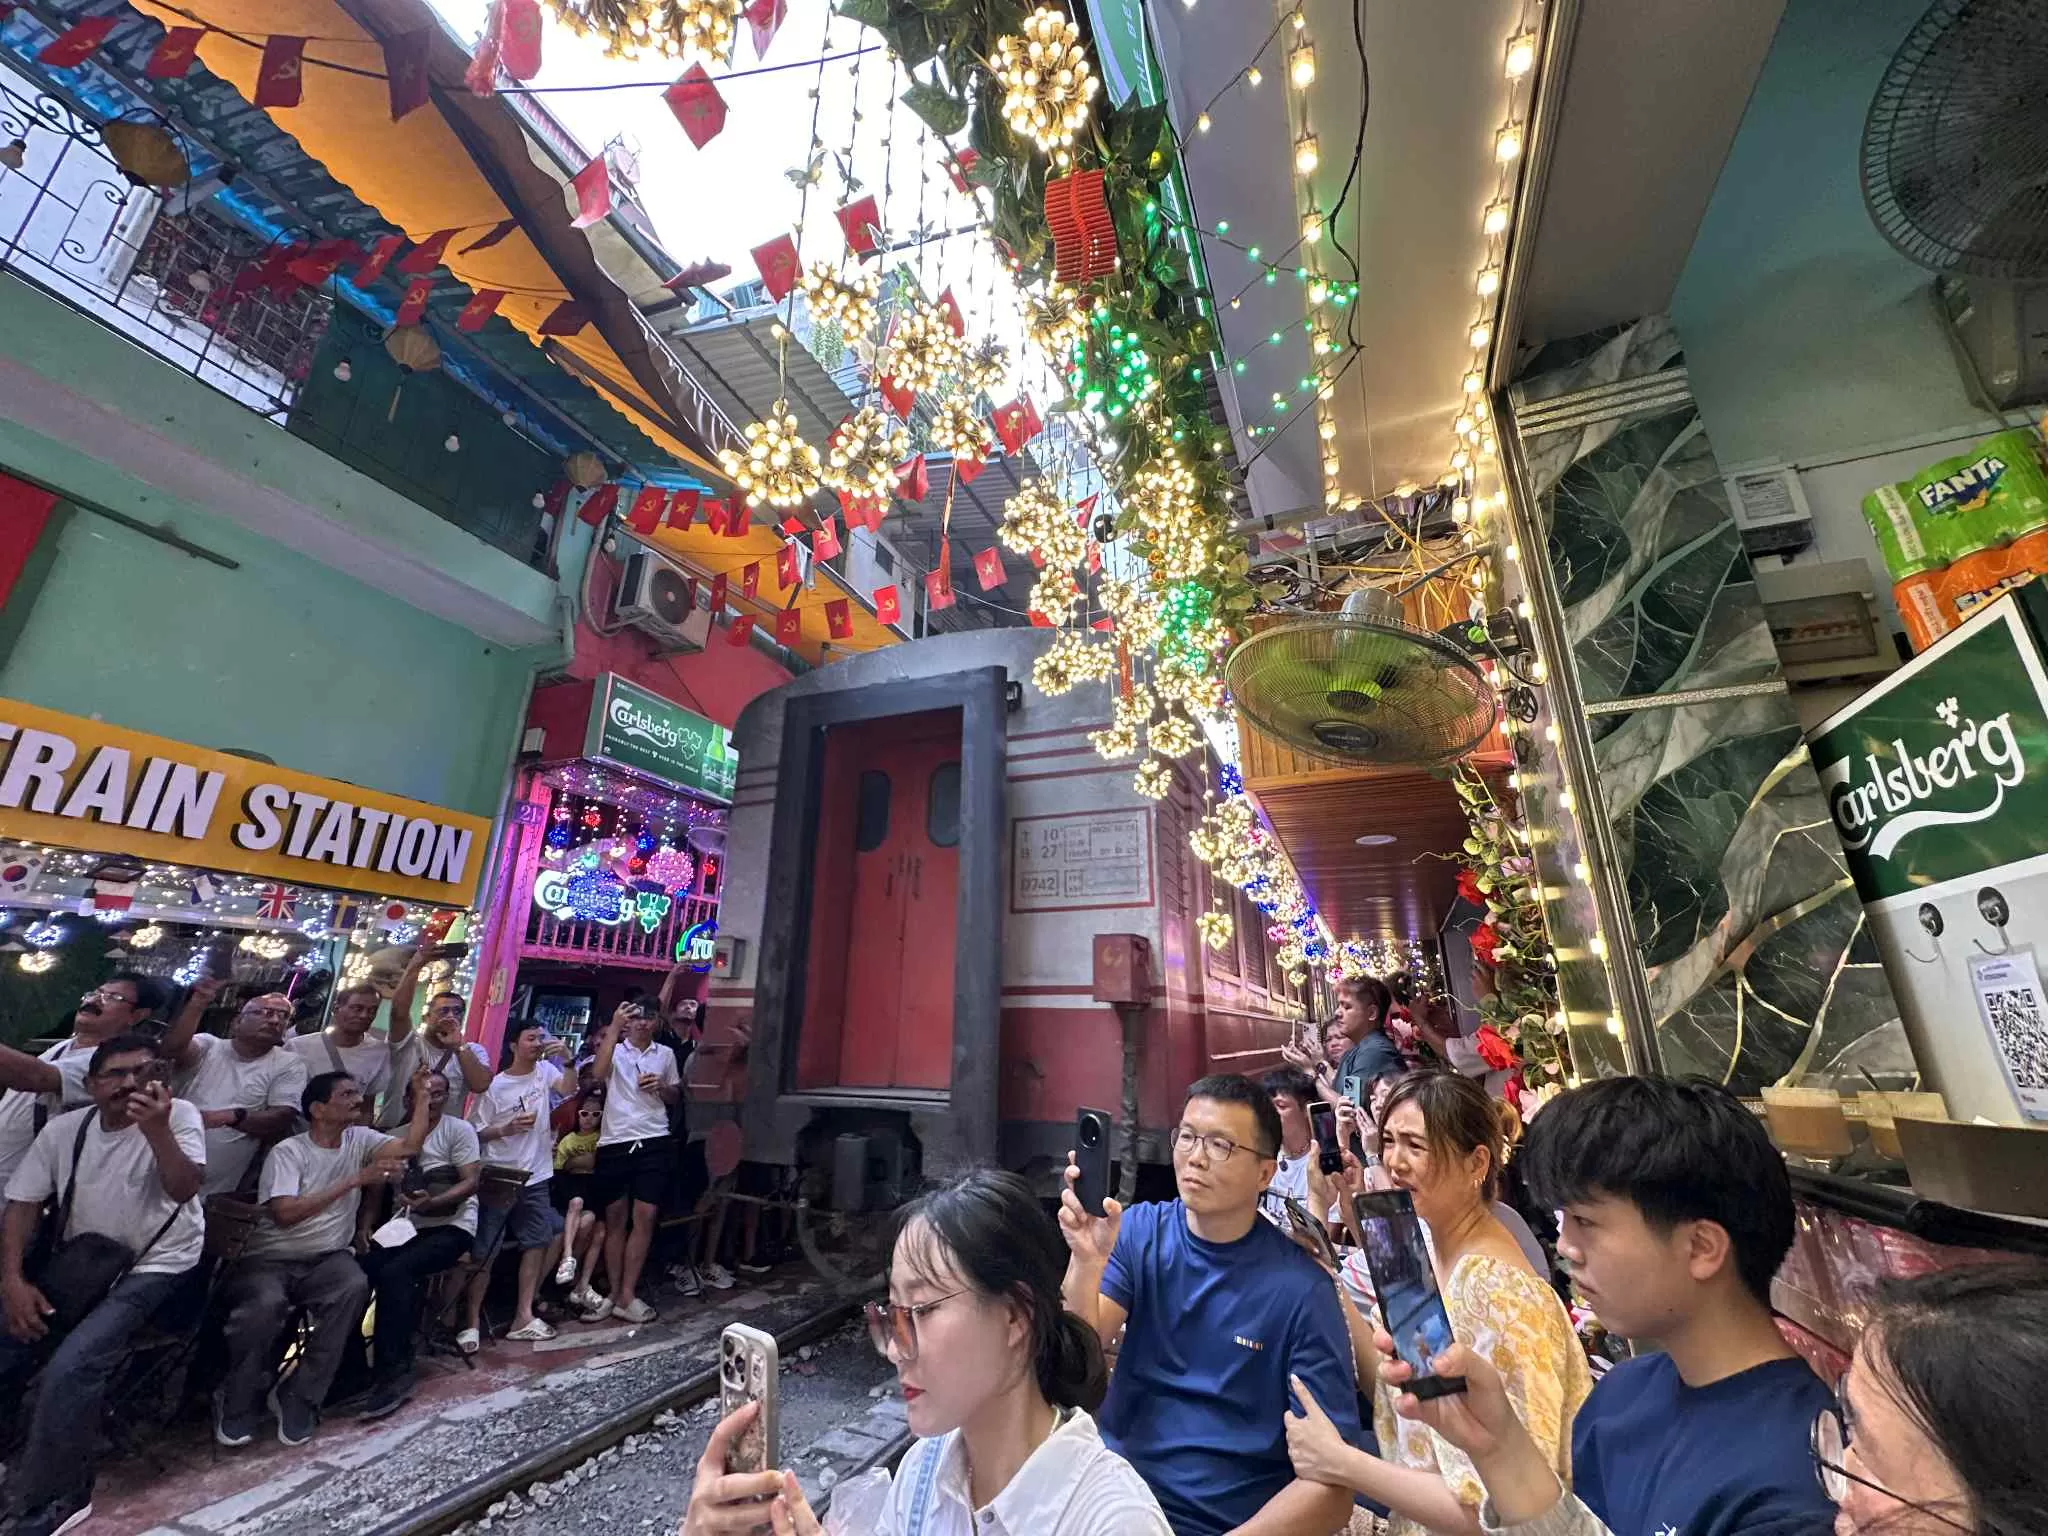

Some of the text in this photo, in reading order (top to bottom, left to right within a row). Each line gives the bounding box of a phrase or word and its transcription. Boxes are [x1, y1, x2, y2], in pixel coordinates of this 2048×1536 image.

[1918, 457, 2007, 508] FANTA
[610, 697, 679, 748] Carlsberg
[1819, 712, 2025, 855] Carlsberg
[234, 784, 473, 884] STATION
